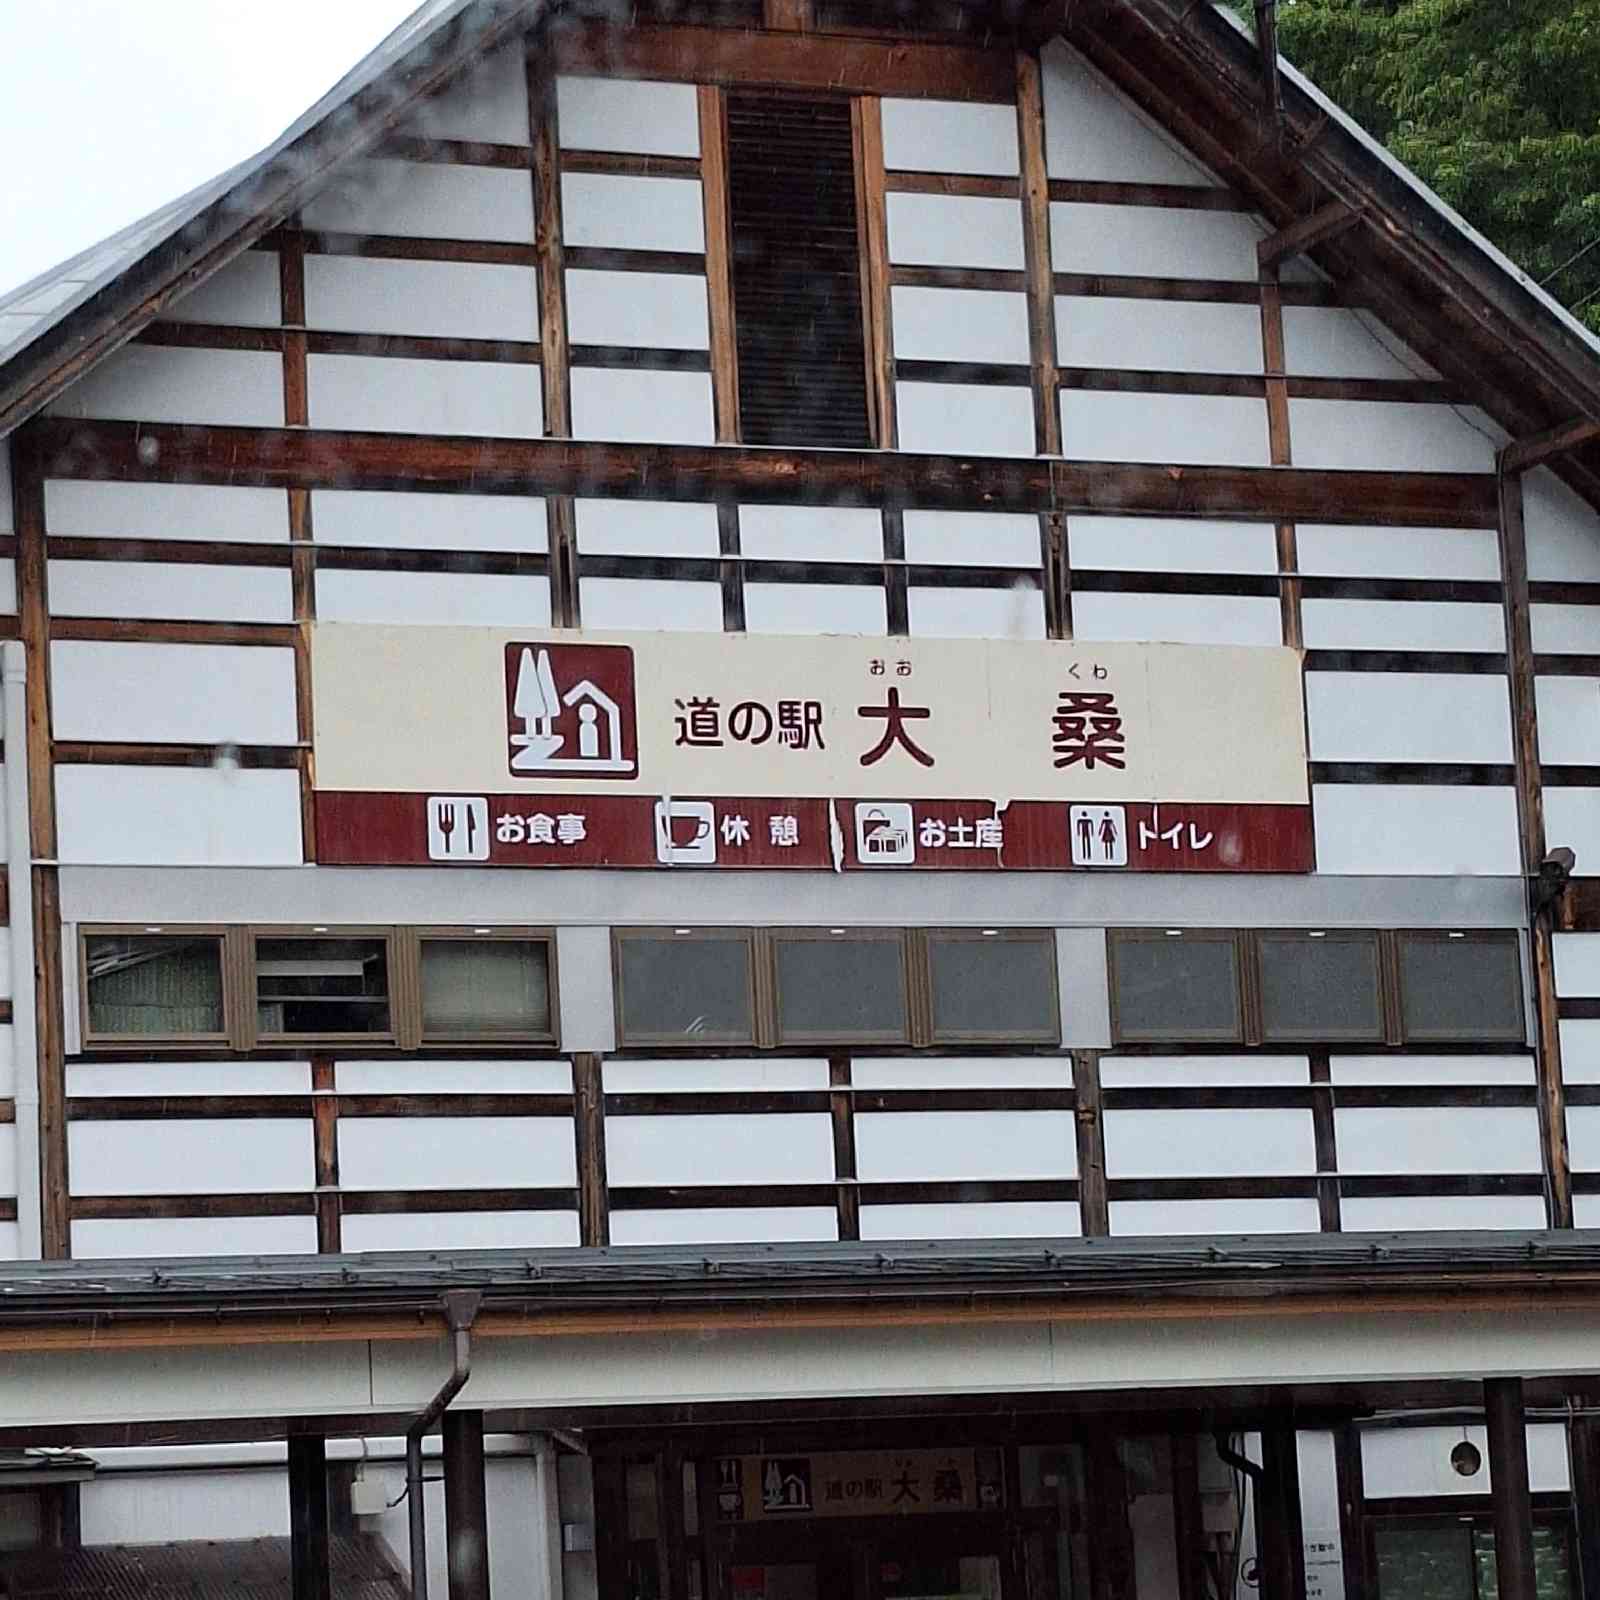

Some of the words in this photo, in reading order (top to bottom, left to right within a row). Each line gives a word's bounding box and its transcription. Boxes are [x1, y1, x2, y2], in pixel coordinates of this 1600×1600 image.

[870, 660, 912, 677] おお
[1068, 663, 1107, 680] くわ
[675, 696, 825, 750] 道の駅
[496, 812, 588, 845] お食事
[919, 817, 1003, 849] お土産
[1138, 820, 1213, 850] トイレ
